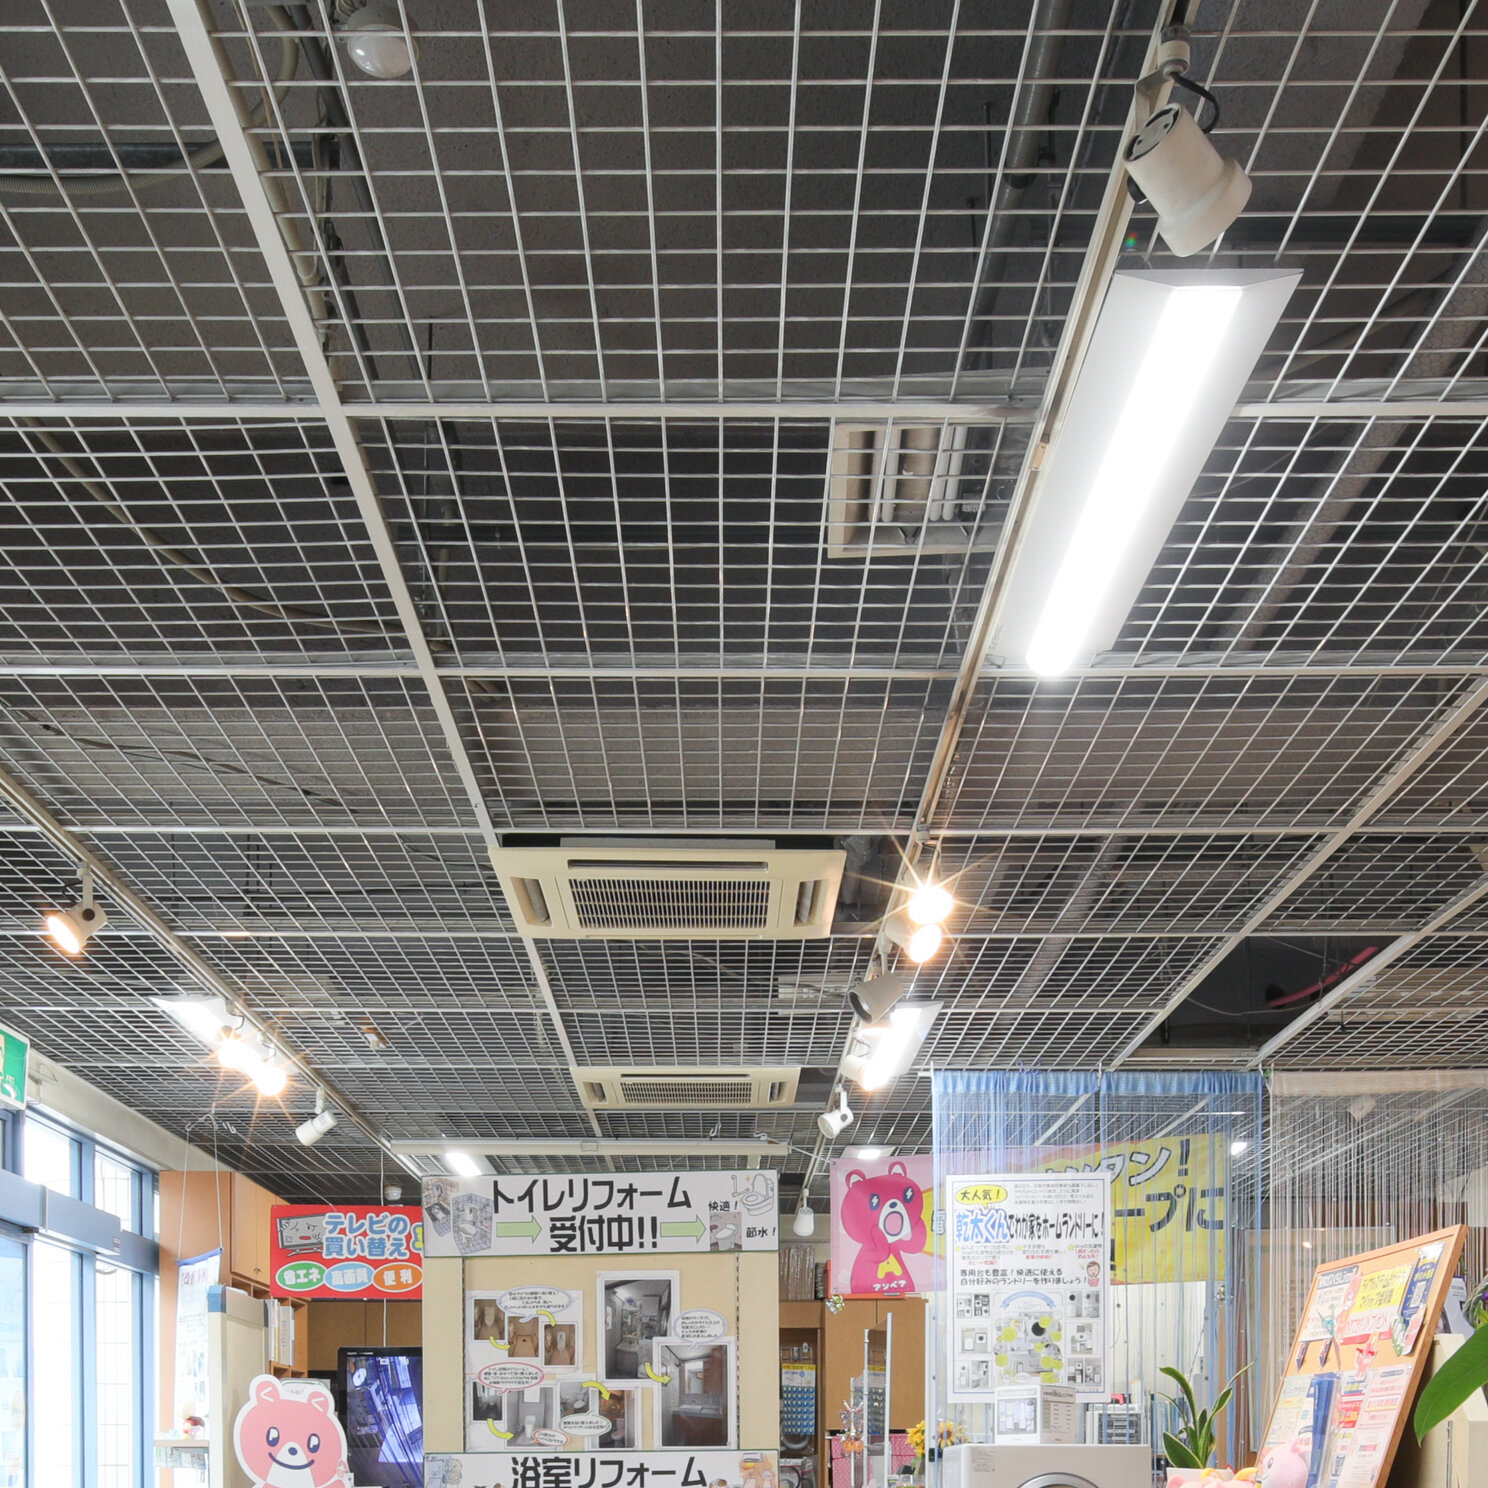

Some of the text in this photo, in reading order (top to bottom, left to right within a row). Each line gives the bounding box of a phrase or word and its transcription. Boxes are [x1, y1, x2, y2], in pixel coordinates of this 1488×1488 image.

[493, 1176, 692, 1214] トイレリフォーム
[324, 1214, 408, 1235] テレビの
[324, 1236, 408, 1258] 買い替え
[283, 1268, 324, 1285] 省エネ
[383, 1269, 413, 1286] 便利
